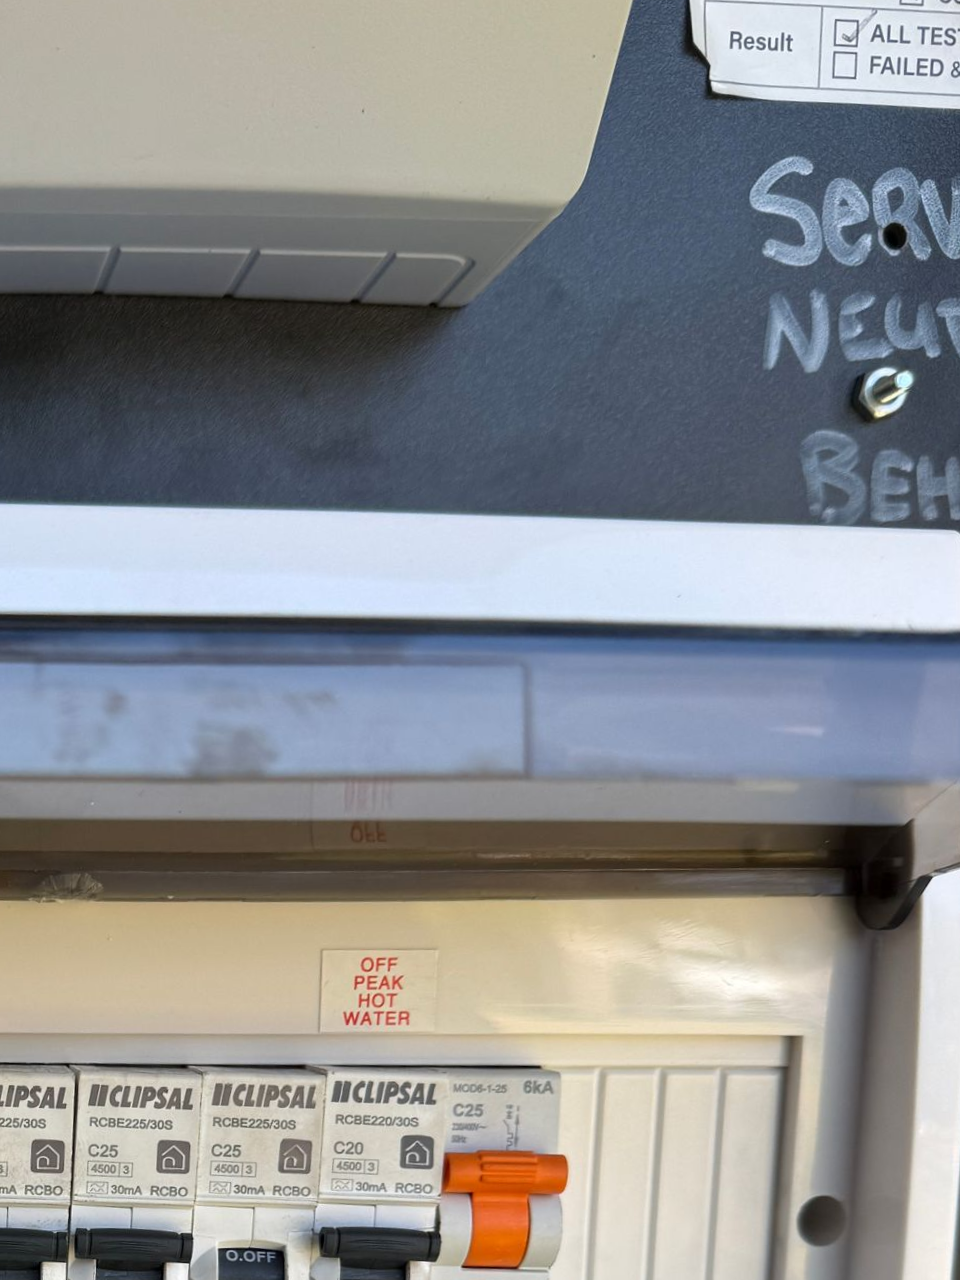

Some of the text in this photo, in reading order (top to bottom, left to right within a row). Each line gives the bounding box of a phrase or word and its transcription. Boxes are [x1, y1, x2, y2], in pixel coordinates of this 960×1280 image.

[729, 30, 794, 52] Result
[870, 24, 911, 45] ALL
[869, 55, 945, 78] FAILED
[360, 956, 398, 972] OFF
[353, 975, 404, 990] PEAK
[358, 993, 398, 1008] HOT
[343, 1010, 411, 1026] WATER
[352, 1080, 437, 1105] CLIPSAL
[453, 1080, 554, 1095] MOD6-1-25 6kA
[110, 1085, 193, 1110] CLIPSAL
[233, 1084, 316, 1109] CLIPSAL
[452, 1103, 484, 1118] C25
[89, 1117, 173, 1130] RCBE225/30S
[212, 1117, 296, 1130] RCBE225/30S
[335, 1114, 419, 1128] RCBE220/30S
[88, 1144, 119, 1158] C25
[211, 1143, 242, 1158] C25
[333, 1141, 364, 1156] C20
[91, 1163, 130, 1175] 4500 3
[214, 1163, 253, 1174] 4500 3
[336, 1161, 375, 1172] 4500 3
[24, 1185, 63, 1196] RCBO
[110, 1184, 188, 1197] 30mA RCBO
[233, 1184, 311, 1197] 30mA RCBO
[355, 1181, 434, 1194] 30mA RCBO
